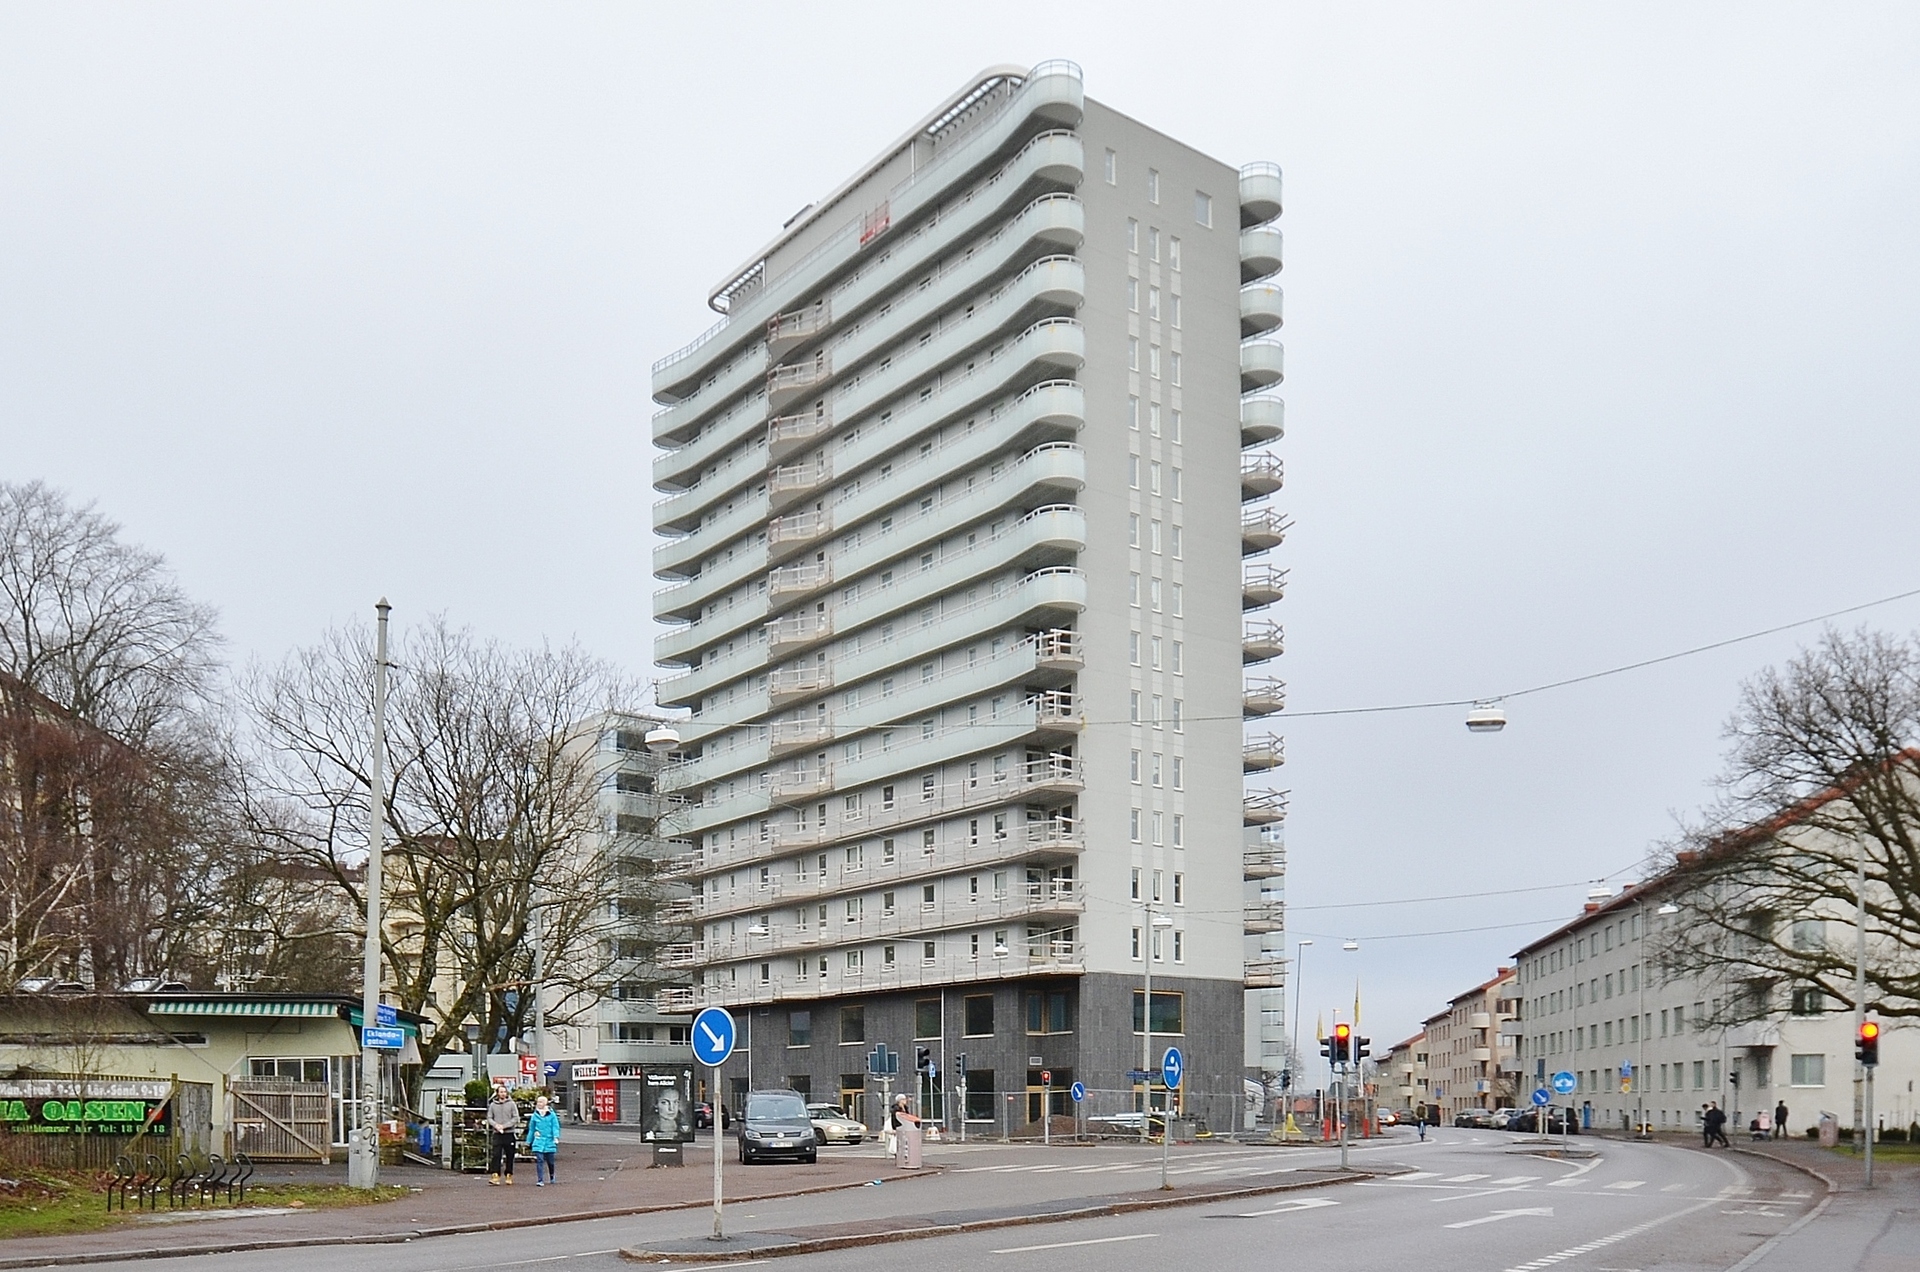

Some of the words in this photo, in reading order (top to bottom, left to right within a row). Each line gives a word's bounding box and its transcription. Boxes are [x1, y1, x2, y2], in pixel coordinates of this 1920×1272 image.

[141, 1085, 166, 1097] 9-19
[42, 1101, 146, 1121] OASEN
[98, 1124, 117, 1133] Tel:
[121, 1124, 133, 1133] 18
[153, 1124, 165, 1133] 18
